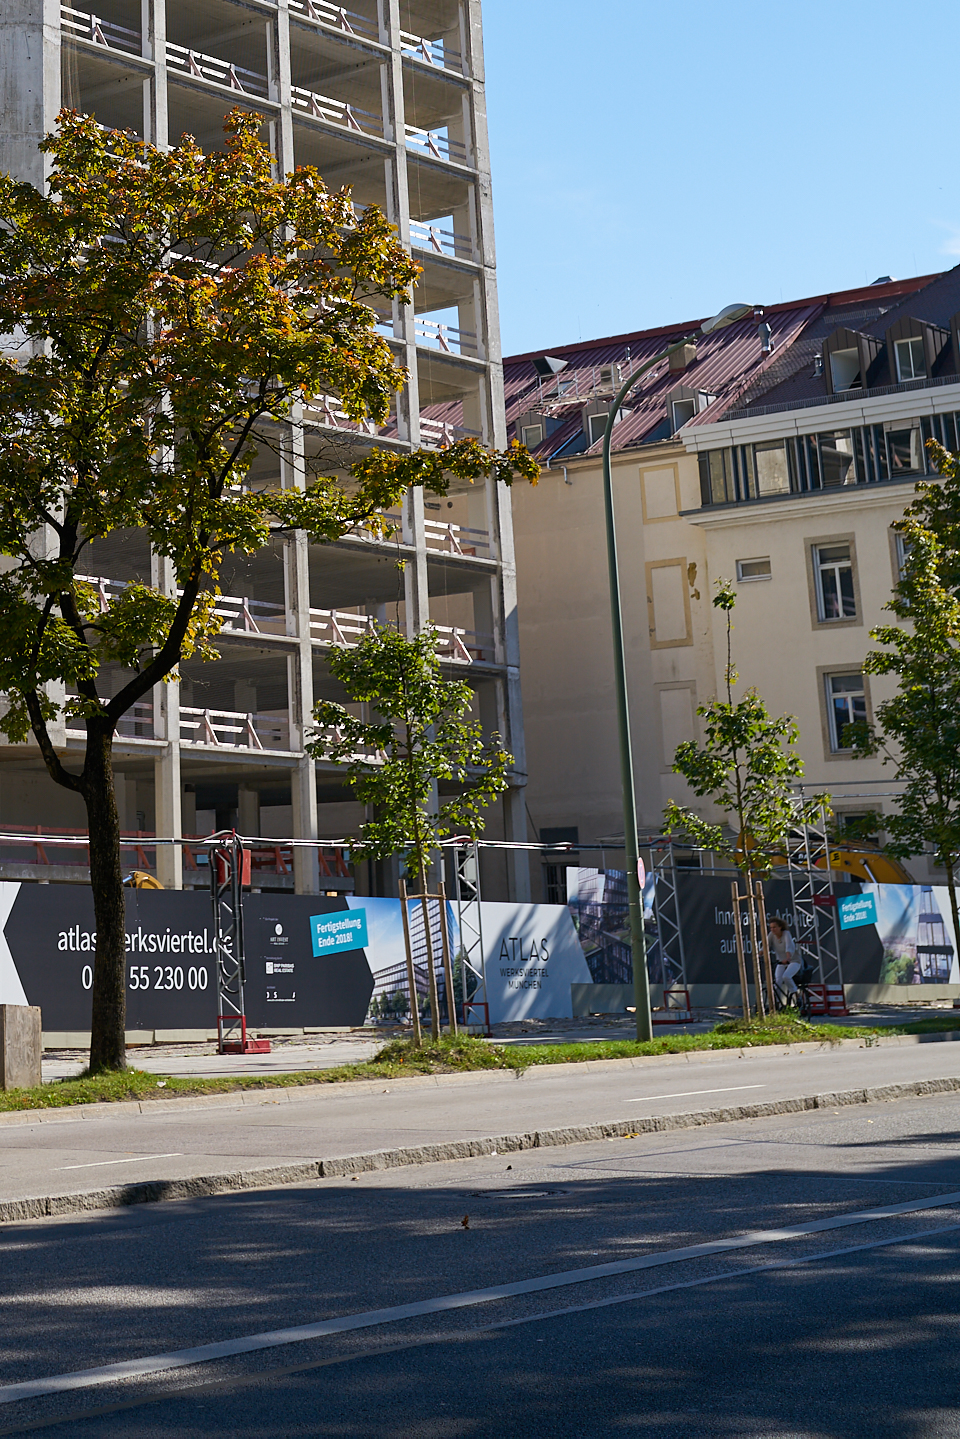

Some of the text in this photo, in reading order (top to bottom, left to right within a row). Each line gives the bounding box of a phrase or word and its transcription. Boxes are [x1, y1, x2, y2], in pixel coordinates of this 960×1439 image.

[316, 918, 362, 934] Fertigstellung
[318, 932, 353, 948] Ende 2018!
[499, 937, 550, 961] ATLAS
[128, 965, 150, 990] 55
[153, 965, 184, 990] 230
[187, 966, 208, 990] 00
[500, 968, 549, 977] WERKSVIERTEL
[508, 977, 542, 990] MÜNCHEN
